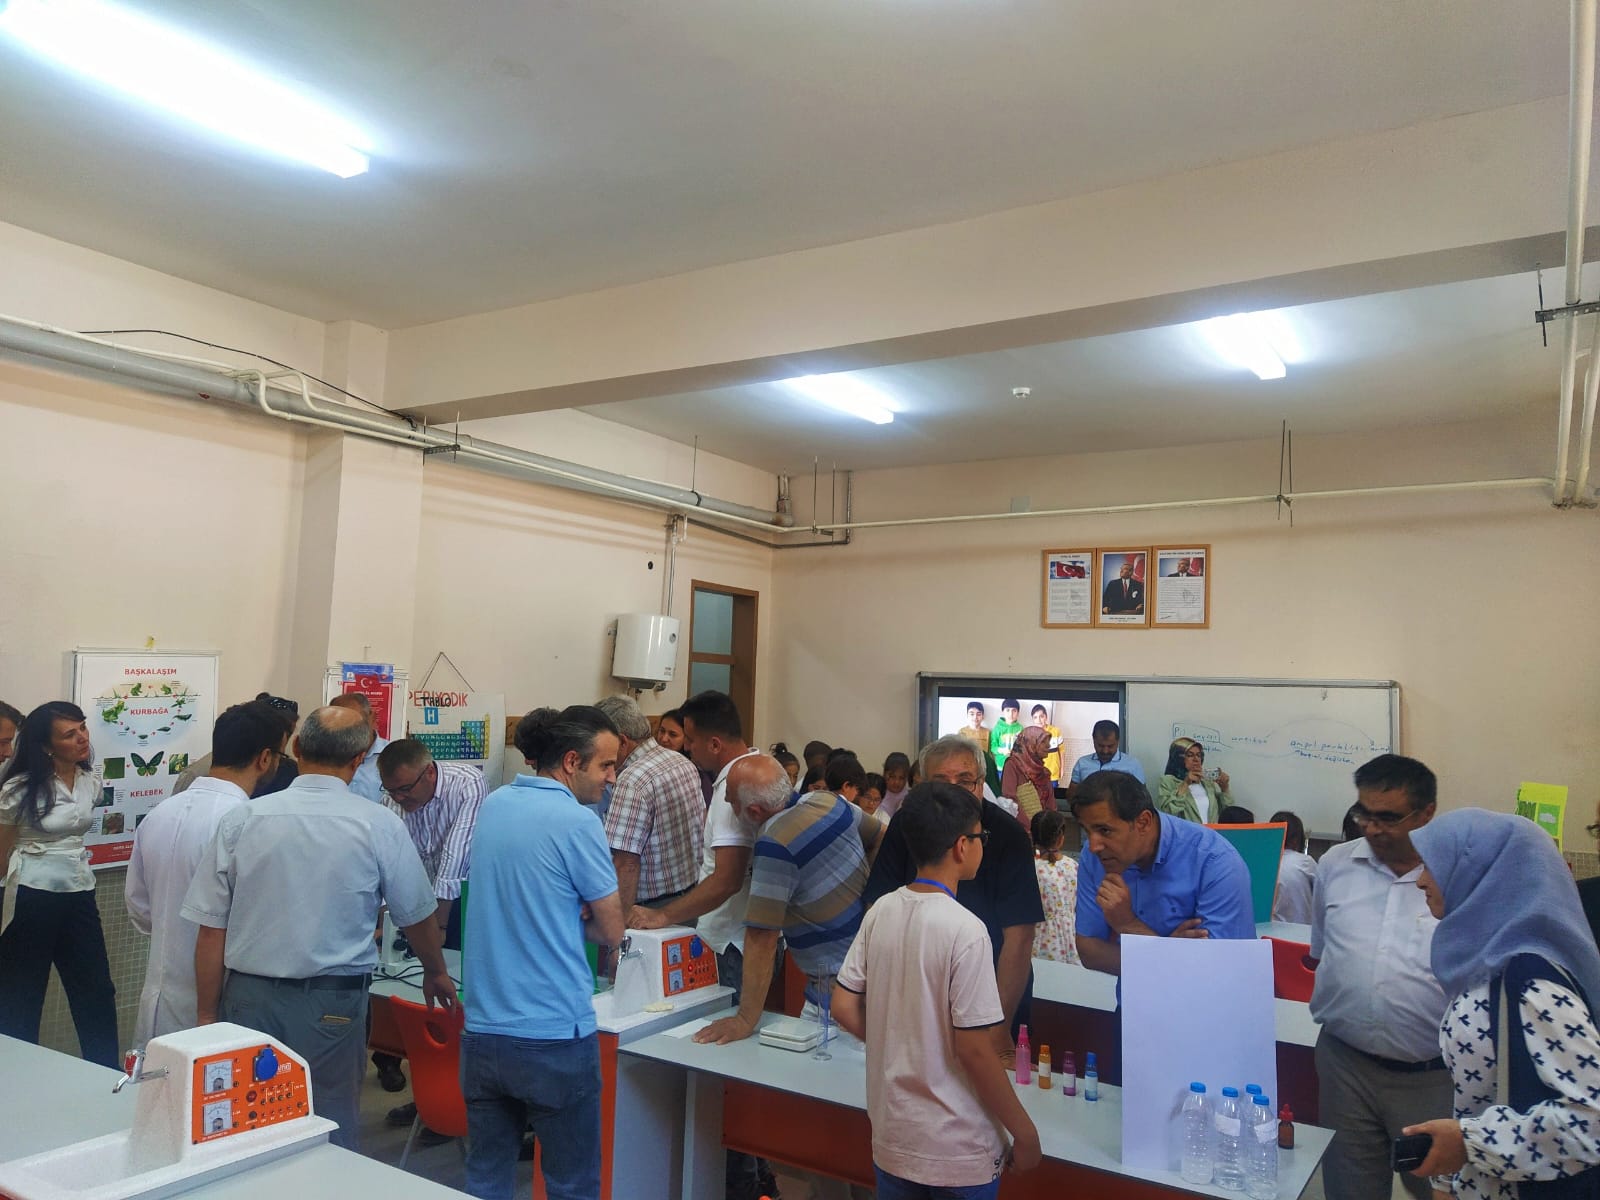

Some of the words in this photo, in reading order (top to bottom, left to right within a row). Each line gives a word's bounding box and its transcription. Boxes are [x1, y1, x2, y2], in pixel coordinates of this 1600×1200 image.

[124, 668, 177, 677] BAŞKALAŞIM
[130, 707, 169, 716] KURBAĞA
[130, 788, 164, 798] KELEBEK
